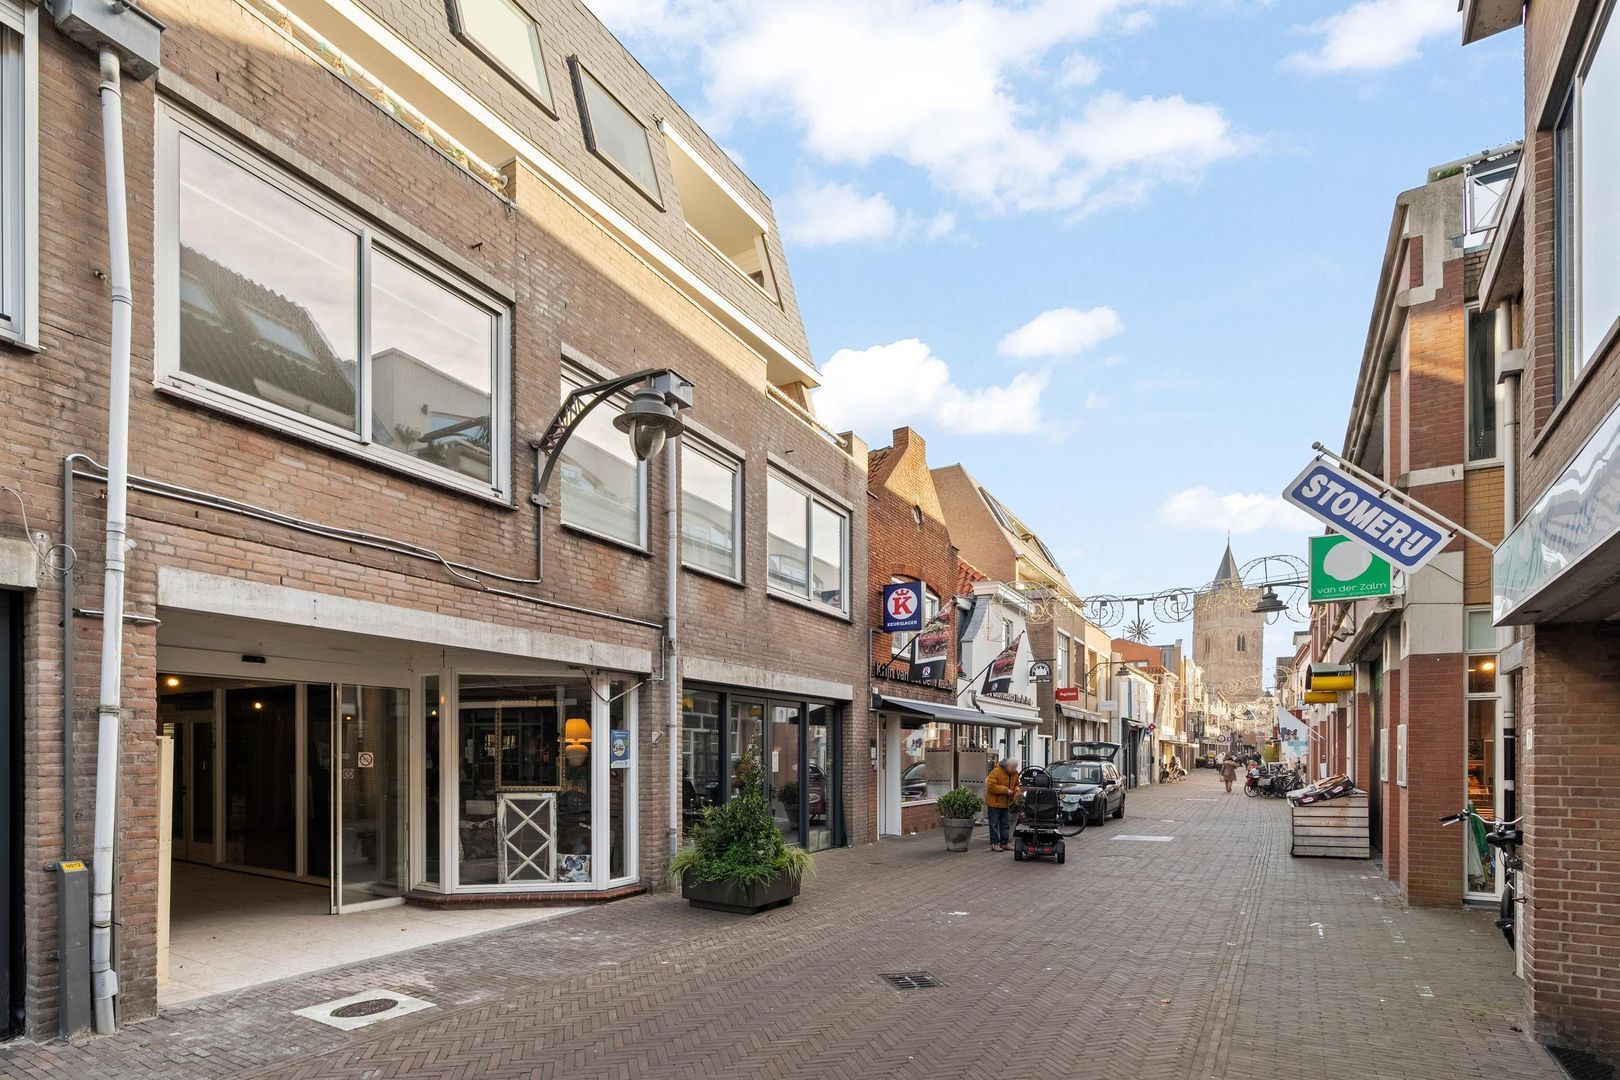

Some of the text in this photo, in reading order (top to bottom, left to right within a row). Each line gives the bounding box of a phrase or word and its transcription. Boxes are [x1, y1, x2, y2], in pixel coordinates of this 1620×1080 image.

[1301, 473, 1433, 557] STOMERIJ
[1338, 584, 1357, 593] der
[1360, 582, 1387, 591] Zalm
[892, 596, 912, 615] K
